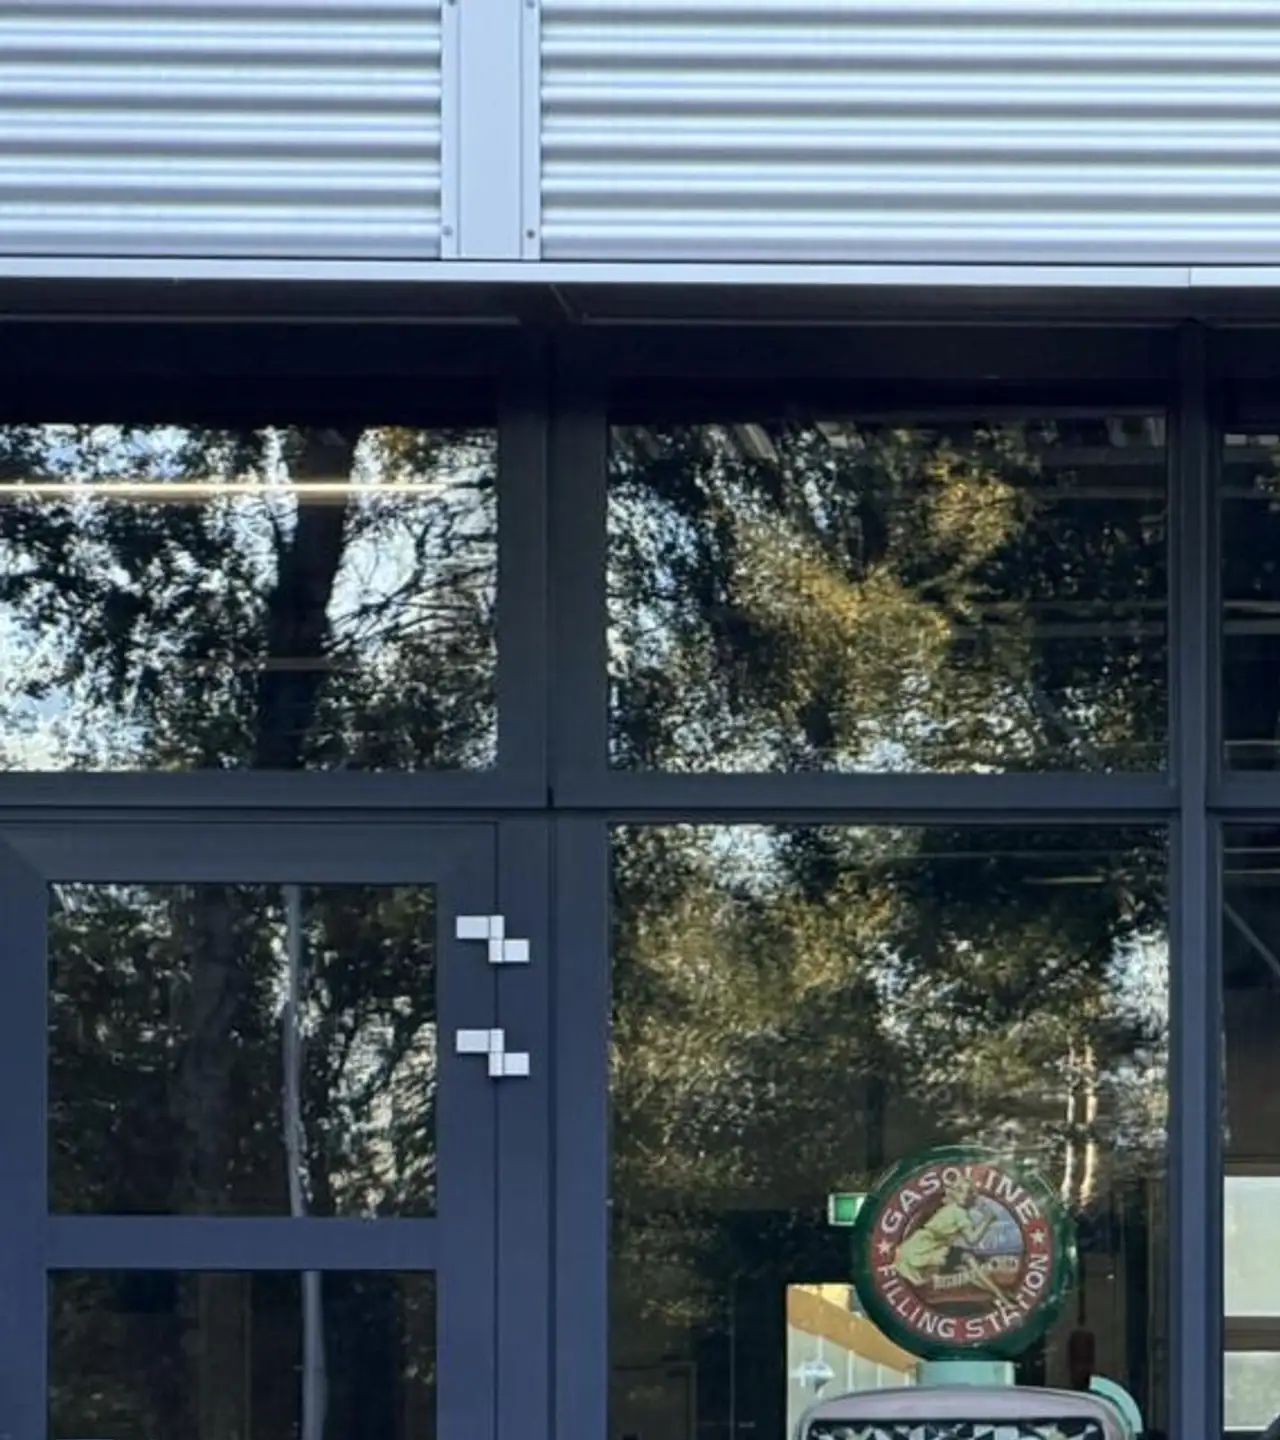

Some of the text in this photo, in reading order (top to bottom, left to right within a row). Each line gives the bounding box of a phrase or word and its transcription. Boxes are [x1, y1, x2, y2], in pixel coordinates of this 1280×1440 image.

[880, 1166, 1042, 1234] GASOLINE
[877, 1253, 1049, 1339] FILLING STATION
